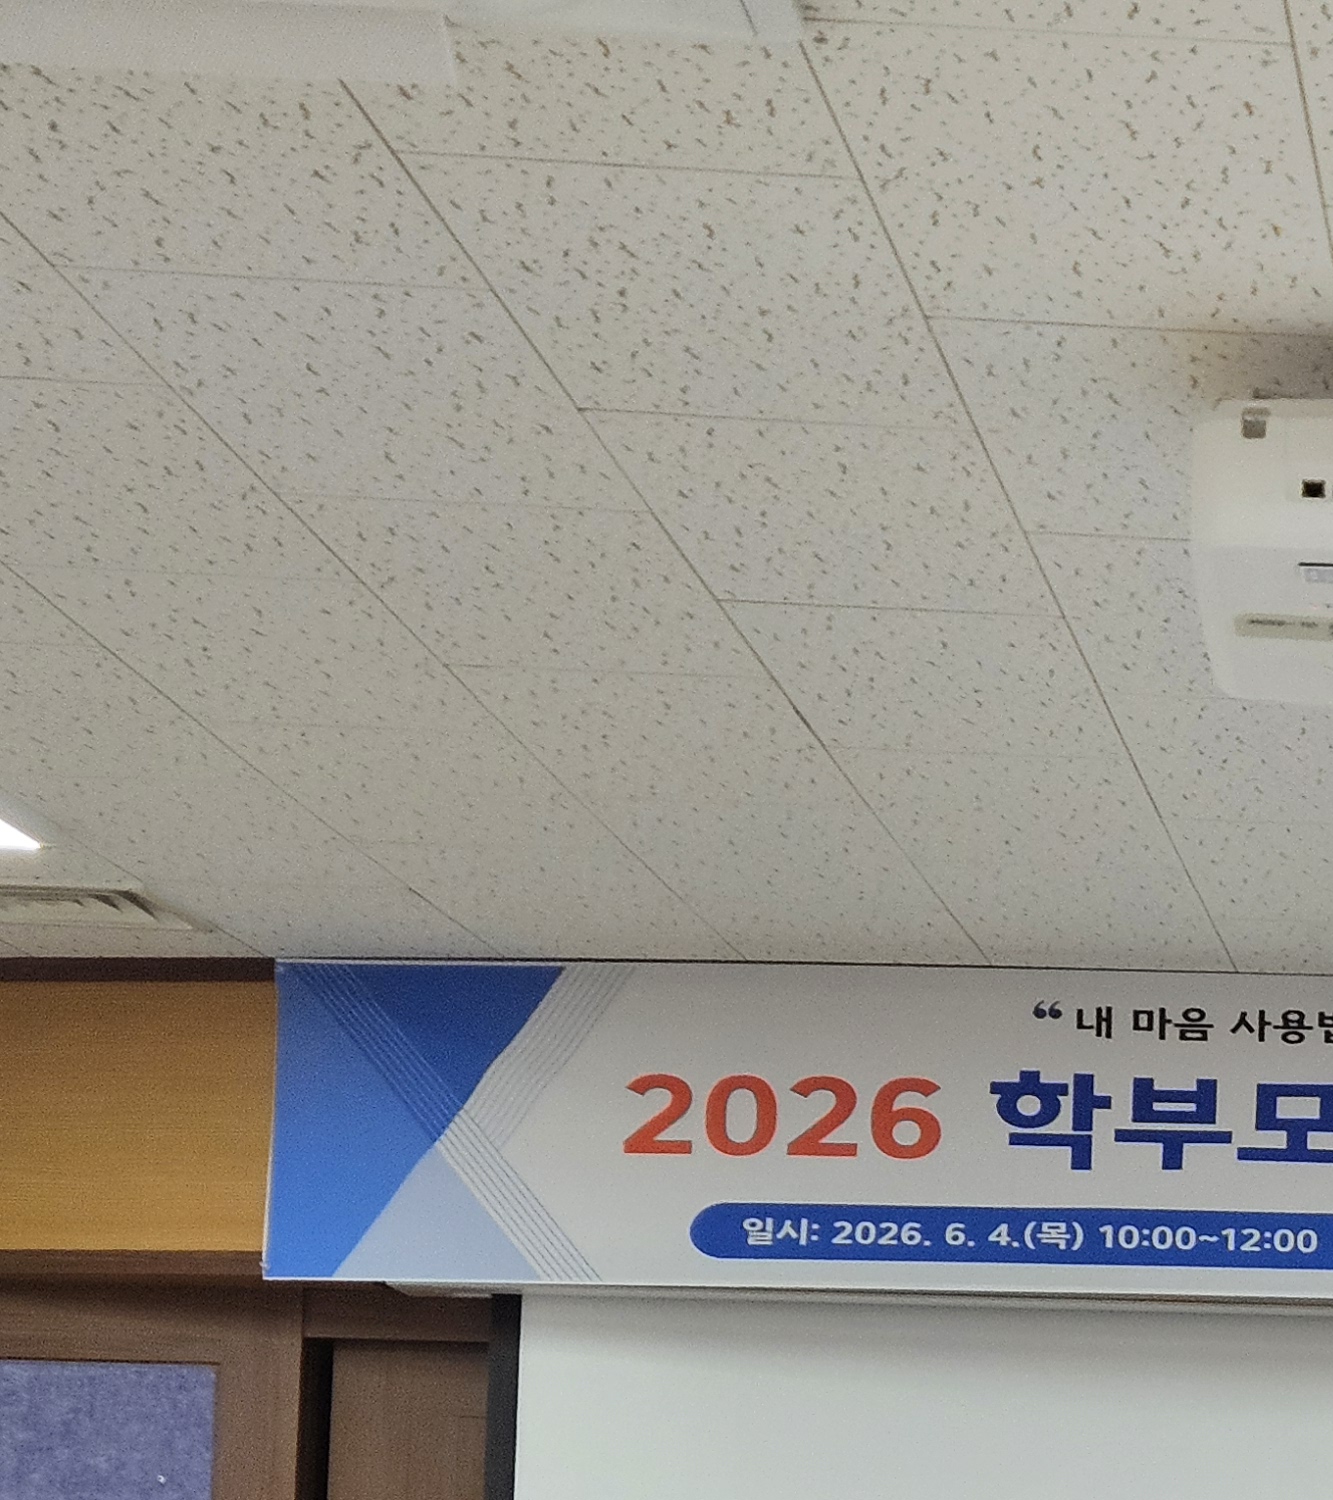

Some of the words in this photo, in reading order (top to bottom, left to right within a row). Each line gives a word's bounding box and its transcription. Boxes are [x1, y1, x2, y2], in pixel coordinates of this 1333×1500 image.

[1132, 1006, 1215, 1042] 마음
[623, 1073, 942, 1160] 2026
[742, 1217, 820, 1246] 일시:
[831, 1220, 932, 1247] 2026.
[945, 1222, 976, 1247] 6.
[987, 1221, 1085, 1251] 4.(목)
[1099, 1225, 1319, 1254] 10:00~12:00
